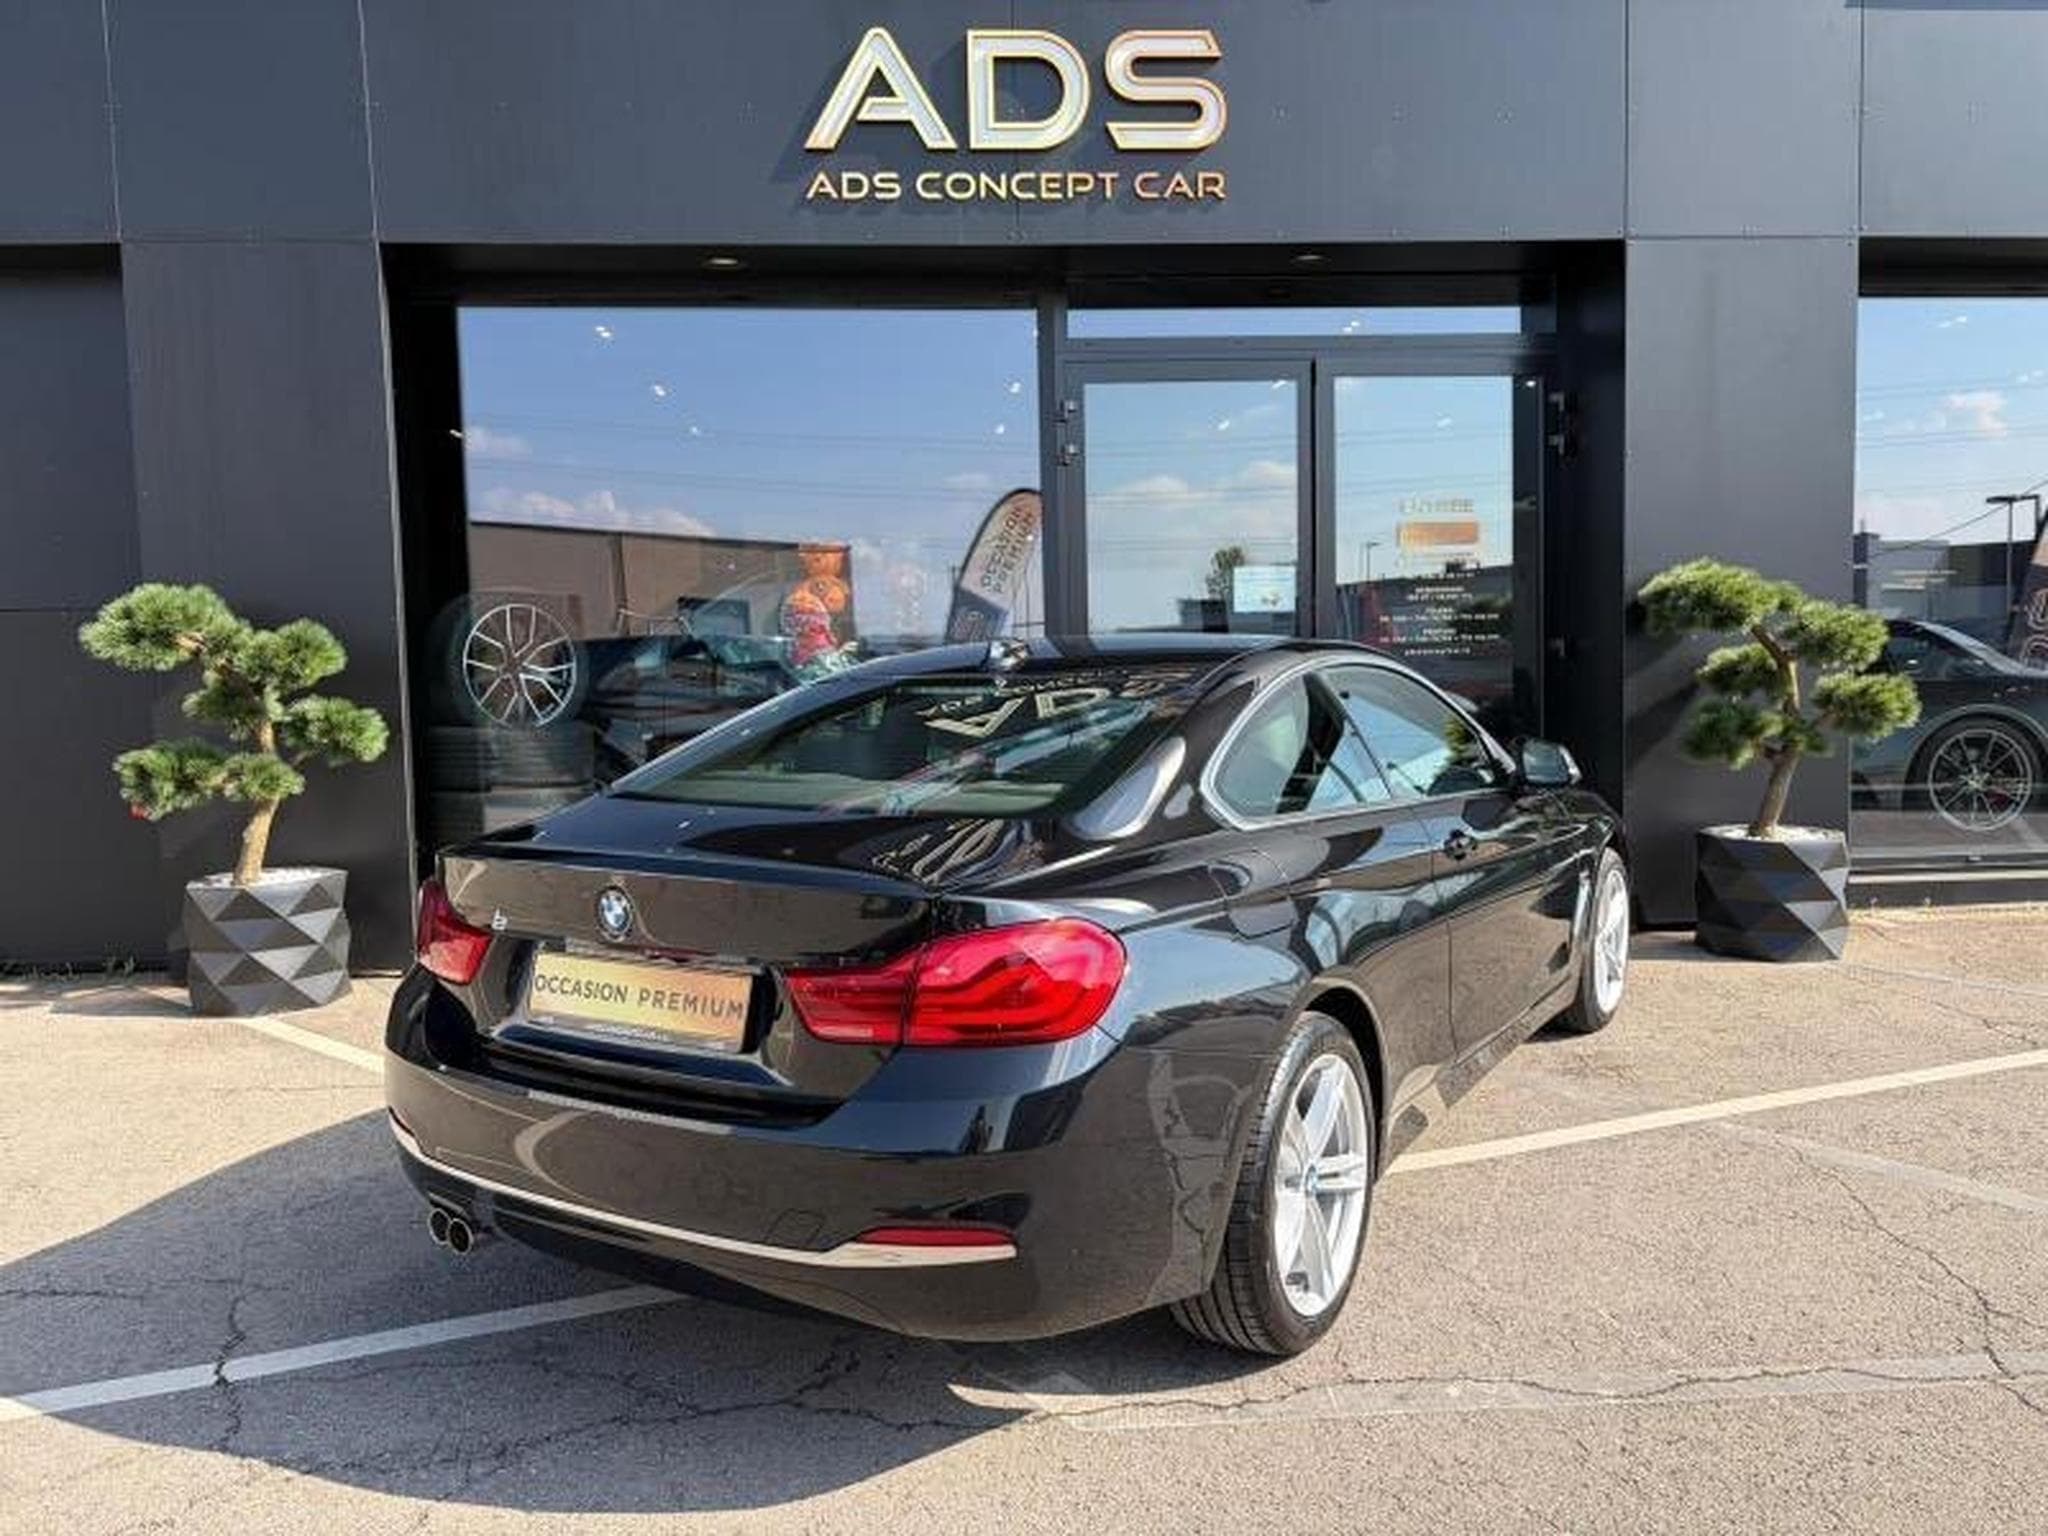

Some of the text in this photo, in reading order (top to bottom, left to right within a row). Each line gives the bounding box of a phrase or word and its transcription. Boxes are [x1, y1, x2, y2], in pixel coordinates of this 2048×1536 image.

[804, 27, 1226, 150] ADS
[806, 171, 1226, 199] ADS CONCEPT CAR
[534, 974, 744, 1018] OCCASION PREMIUM
